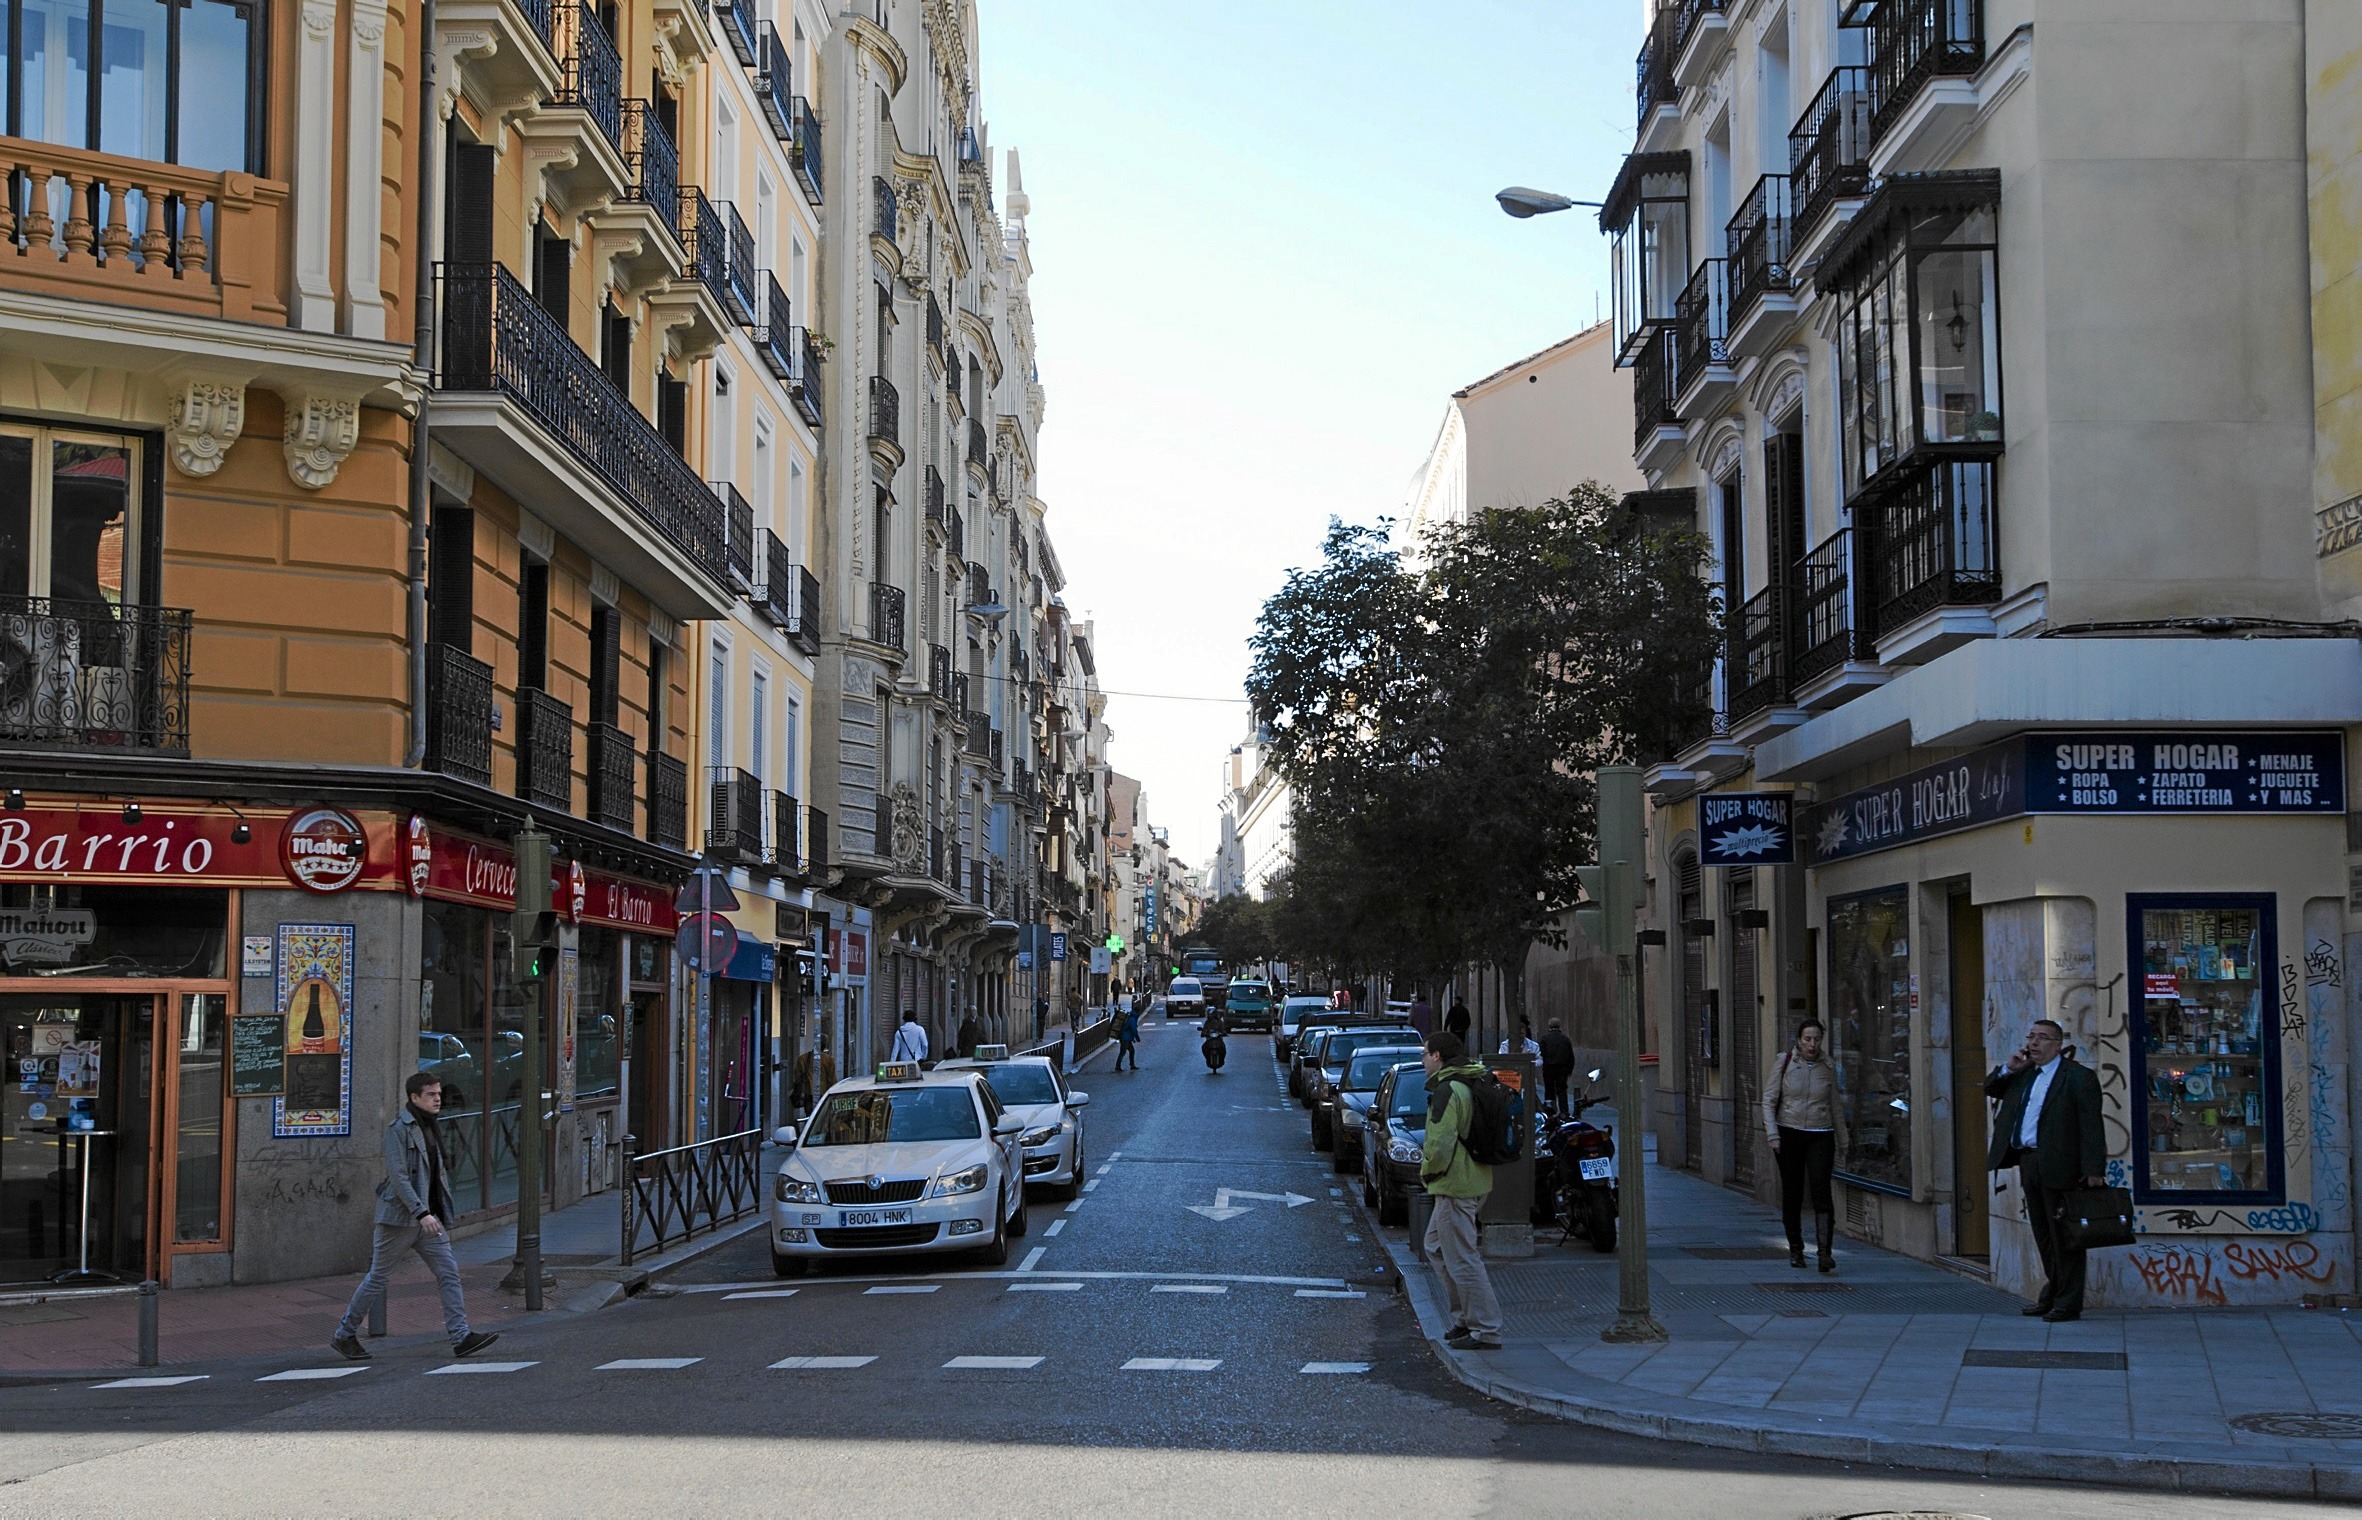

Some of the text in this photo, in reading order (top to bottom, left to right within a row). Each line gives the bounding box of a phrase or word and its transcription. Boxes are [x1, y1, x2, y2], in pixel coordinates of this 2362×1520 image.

[2056, 744, 2239, 770] SUPER HOGAR
[2259, 754, 2314, 771] MENAJE
[2072, 772, 2110, 788] ROPA
[2152, 772, 2206, 788] ZAPATO
[2259, 772, 2320, 788] JUGUETE
[2072, 788, 2118, 805] BOLSO
[2152, 788, 2233, 805] FERRETERIA
[2260, 789, 2269, 805] Y
[2280, 789, 2313, 805] MAS
[1706, 799, 1787, 826] SUPER HOGAR
[1854, 766, 1972, 845] SUPER HOGAR
[0, 818, 213, 874] Barrio
[292, 838, 348, 856] Maho
[466, 844, 516, 897] Cervece
[607, 879, 652, 925] El Barrio
[1053, 936, 1064, 958] PILATES
[886, 1066, 906, 1078] TAXI
[833, 1097, 858, 1111] LIBRE
[1586, 1158, 1608, 1169] 6659
[803, 1215, 819, 1224] SP
[849, 1211, 907, 1225] 8004 HNK
